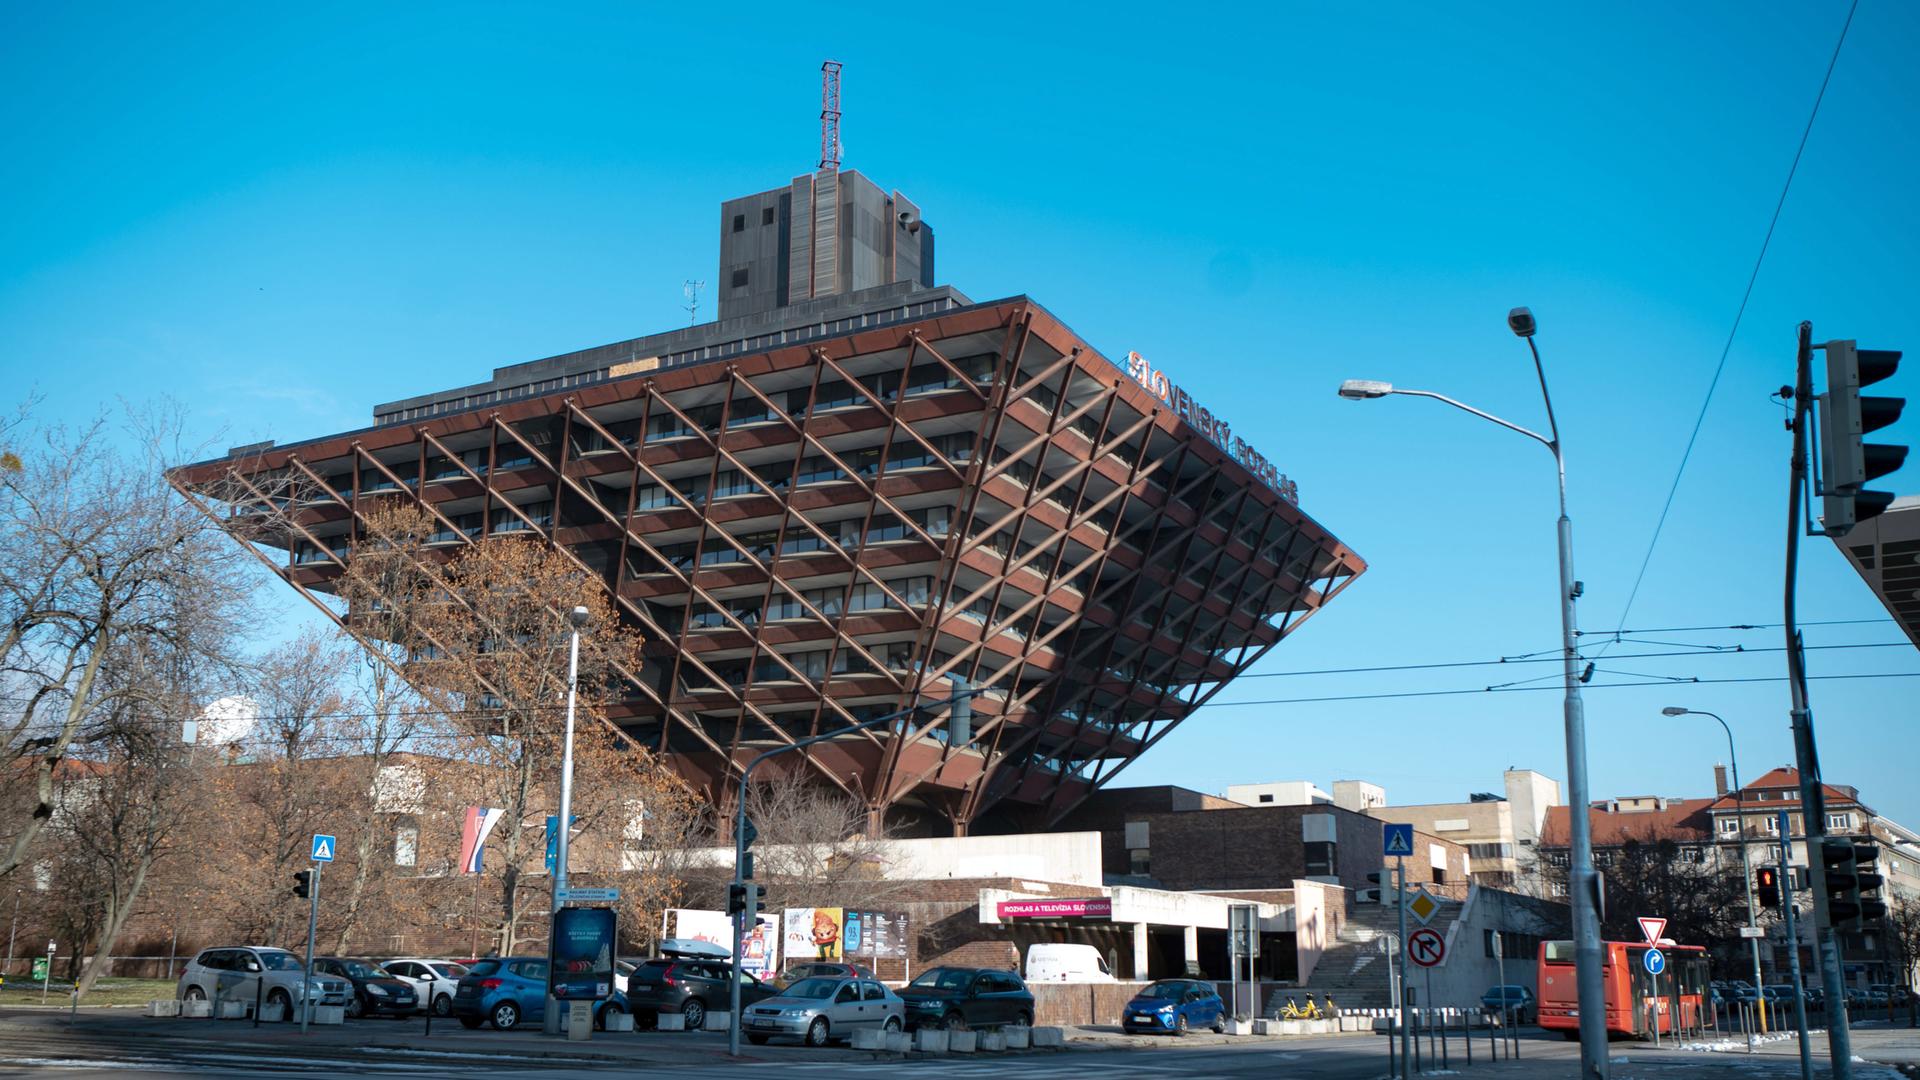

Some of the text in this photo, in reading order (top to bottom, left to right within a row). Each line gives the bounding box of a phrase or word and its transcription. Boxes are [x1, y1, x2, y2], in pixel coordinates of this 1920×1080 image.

[1128, 351, 1299, 505] SLOVENSKÝ ROZHLAS
[1004, 905, 1034, 913] ROZHLAS
[1040, 903, 1072, 912] TELEVÍZIA
[1073, 903, 1110, 912] SLOVENSKA
